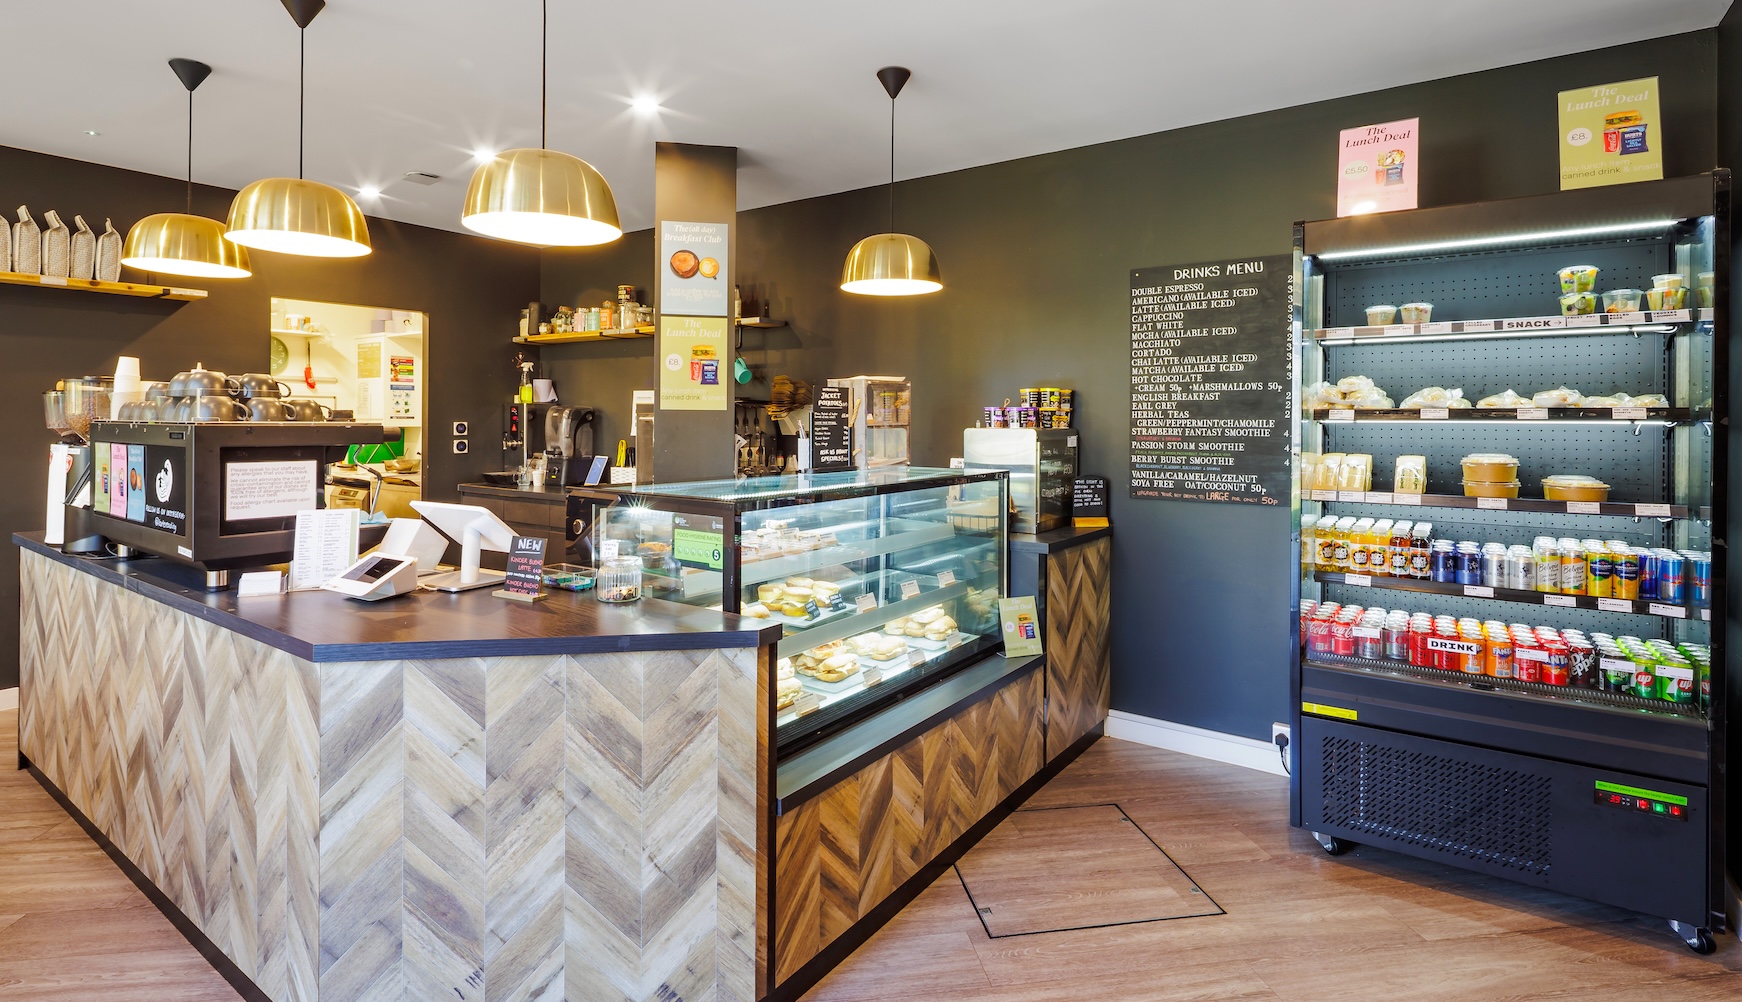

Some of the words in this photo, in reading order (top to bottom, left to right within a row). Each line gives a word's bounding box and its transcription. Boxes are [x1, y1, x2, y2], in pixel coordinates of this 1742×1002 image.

[1591, 87, 1618, 98] The
[1567, 98, 1610, 112] Lunch
[1615, 91, 1649, 105] Deal
[1366, 127, 1387, 136] The
[1346, 136, 1380, 148] Lunch
[1384, 130, 1411, 141] Deal
[1345, 166, 1368, 175] £5.50
[1562, 165, 1579, 173] Any
[1581, 160, 1607, 170] lunch
[1562, 170, 1595, 180] canned
[1598, 168, 1621, 176] drink
[1632, 162, 1660, 171] snack
[664, 234, 702, 243] Breakfast
[1174, 266, 1220, 280] DRINKS
[1226, 262, 1264, 276] MENU
[1132, 287, 1162, 296] DOUBLE
[1165, 283, 1204, 294] ESPRESSO
[1233, 288, 1259, 297] ICED)
[1210, 300, 1236, 309] ICED)
[1132, 313, 1184, 323] CAPPUCCINO
[684, 320, 702, 328] The
[1132, 323, 1153, 331] FLAT
[1156, 321, 1184, 330] WHITE
[1507, 320, 1551, 328] SNACK
[666, 328, 696, 337] Lunch
[699, 329, 722, 338] Deal
[1212, 327, 1237, 336] ICED)
[1132, 340, 1181, 349] MACCHIATO
[1132, 349, 1172, 358] CORTADO
[1131, 358, 1151, 366] CHAI
[1232, 354, 1258, 362] ICED)
[1219, 363, 1244, 372] ICED)
[1132, 376, 1148, 384] HOT
[1151, 374, 1202, 383] CHOCOLATE
[1170, 384, 1182, 393] 50p
[1268, 383, 1282, 392] 50p
[1132, 402, 1152, 410] EARL
[1132, 428, 1183, 436] STRAWBERRY
[1185, 428, 1222, 436] FANTASY
[1225, 429, 1271, 437] SMOOTHIE
[1167, 442, 1196, 450] STORM
[1198, 443, 1245, 451] SMOOTHIE
[1190, 457, 1234, 466] SMOOTHIE
[1132, 480, 1150, 488] SOYA
[1185, 482, 1246, 491] OAT/COCONUT
[1251, 485, 1266, 495] 50p
[1206, 492, 1230, 501] LARGE
[1262, 497, 1278, 505] 50p
[518, 538, 542, 551] NEW
[714, 550, 719, 560] 5
[1310, 621, 1328, 635] Cola
[1431, 641, 1474, 652] DRINK
[1571, 652, 1584, 665] Dr
